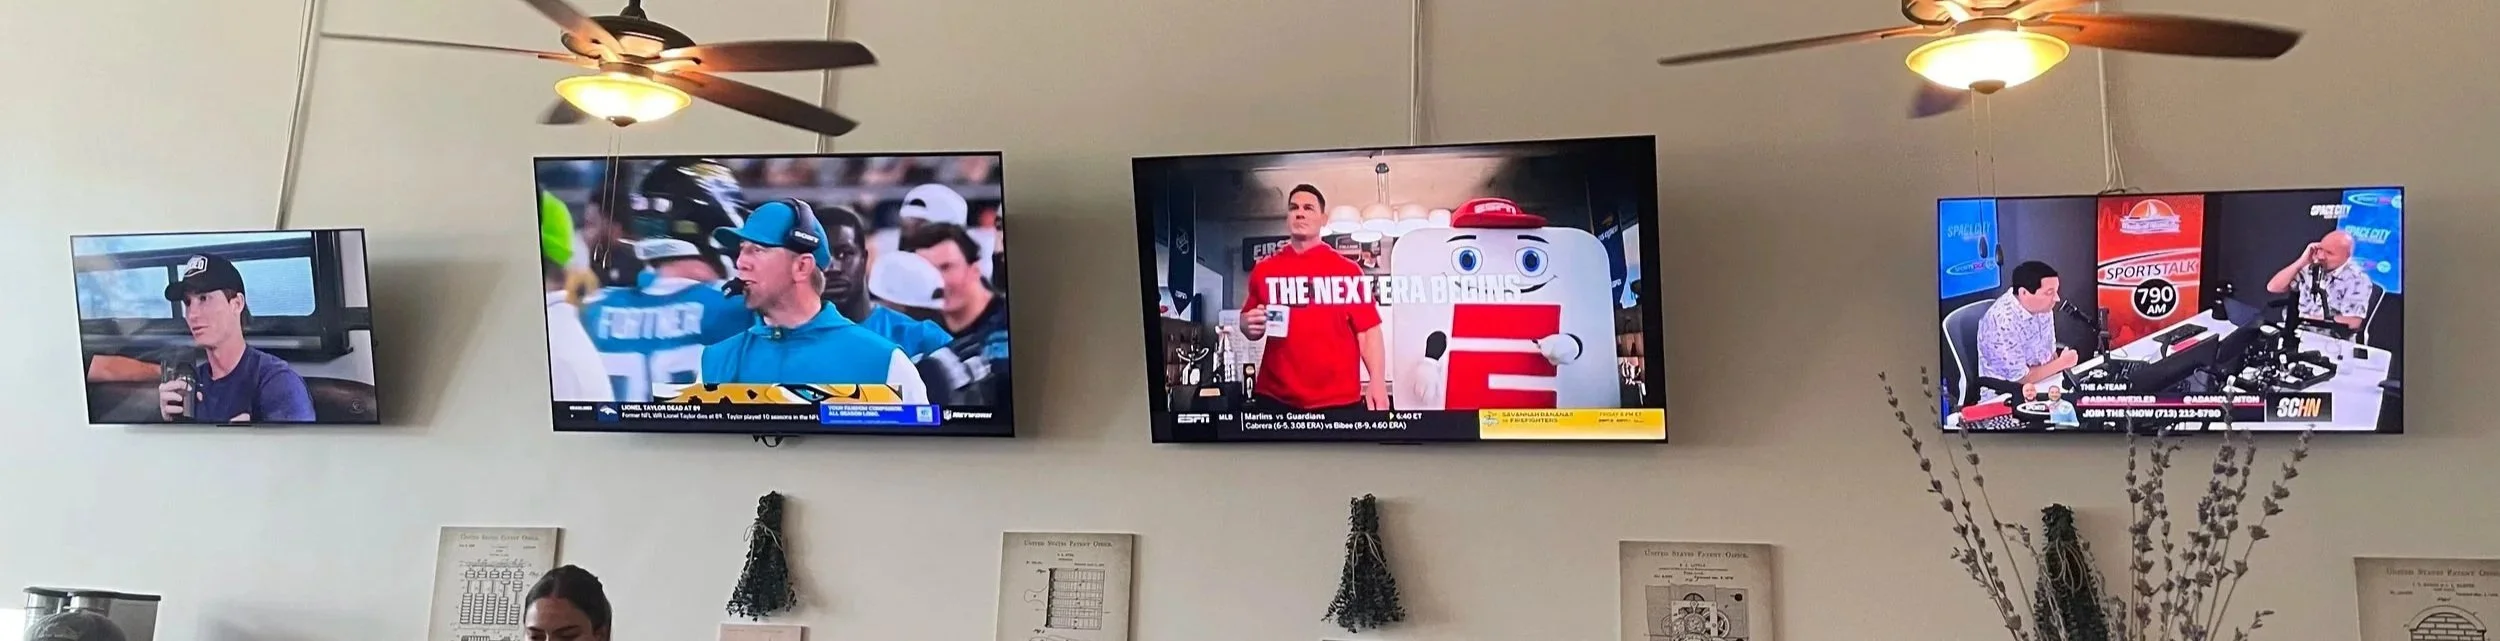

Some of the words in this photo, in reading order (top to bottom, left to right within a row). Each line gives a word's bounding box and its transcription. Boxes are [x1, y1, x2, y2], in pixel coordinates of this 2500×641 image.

[1474, 202, 1517, 215] ESPN
[2310, 204, 2335, 216] SPACE
[2335, 204, 2352, 216] CITY
[1947, 223, 1973, 238] SPACE
[2344, 225, 2369, 238] SPACE
[2370, 228, 2391, 241] CITY
[794, 231, 819, 243] SONY
[1253, 240, 1291, 261] FIRS
[2106, 260, 2196, 280] SPORTSTALK
[1265, 276, 1310, 305] THE
[1313, 275, 1374, 305] NEXT
[1379, 275, 1426, 304] ERA
[1430, 274, 1522, 304] BEGINS
[2137, 286, 2174, 305] 790
[2146, 304, 2167, 315] AM
[2096, 383, 2127, 391] A-TEAM
[2083, 409, 2105, 418] JOIN
[2106, 409, 2125, 418] THE
[2155, 409, 2177, 418] (713)
[2276, 397, 2322, 418] SCHN
[952, 411, 993, 419] NETWORK
[1178, 413, 1210, 423] ESPN
[1245, 413, 1273, 421] Marlins
[1286, 412, 1326, 420] Guardians
[1245, 422, 1273, 430] Cabrera
[1291, 422, 1306, 430] 3.08
[1307, 421, 1324, 430] ERA)
[1333, 422, 1354, 430] Bibee
[1389, 421, 1407, 430] ERA)
